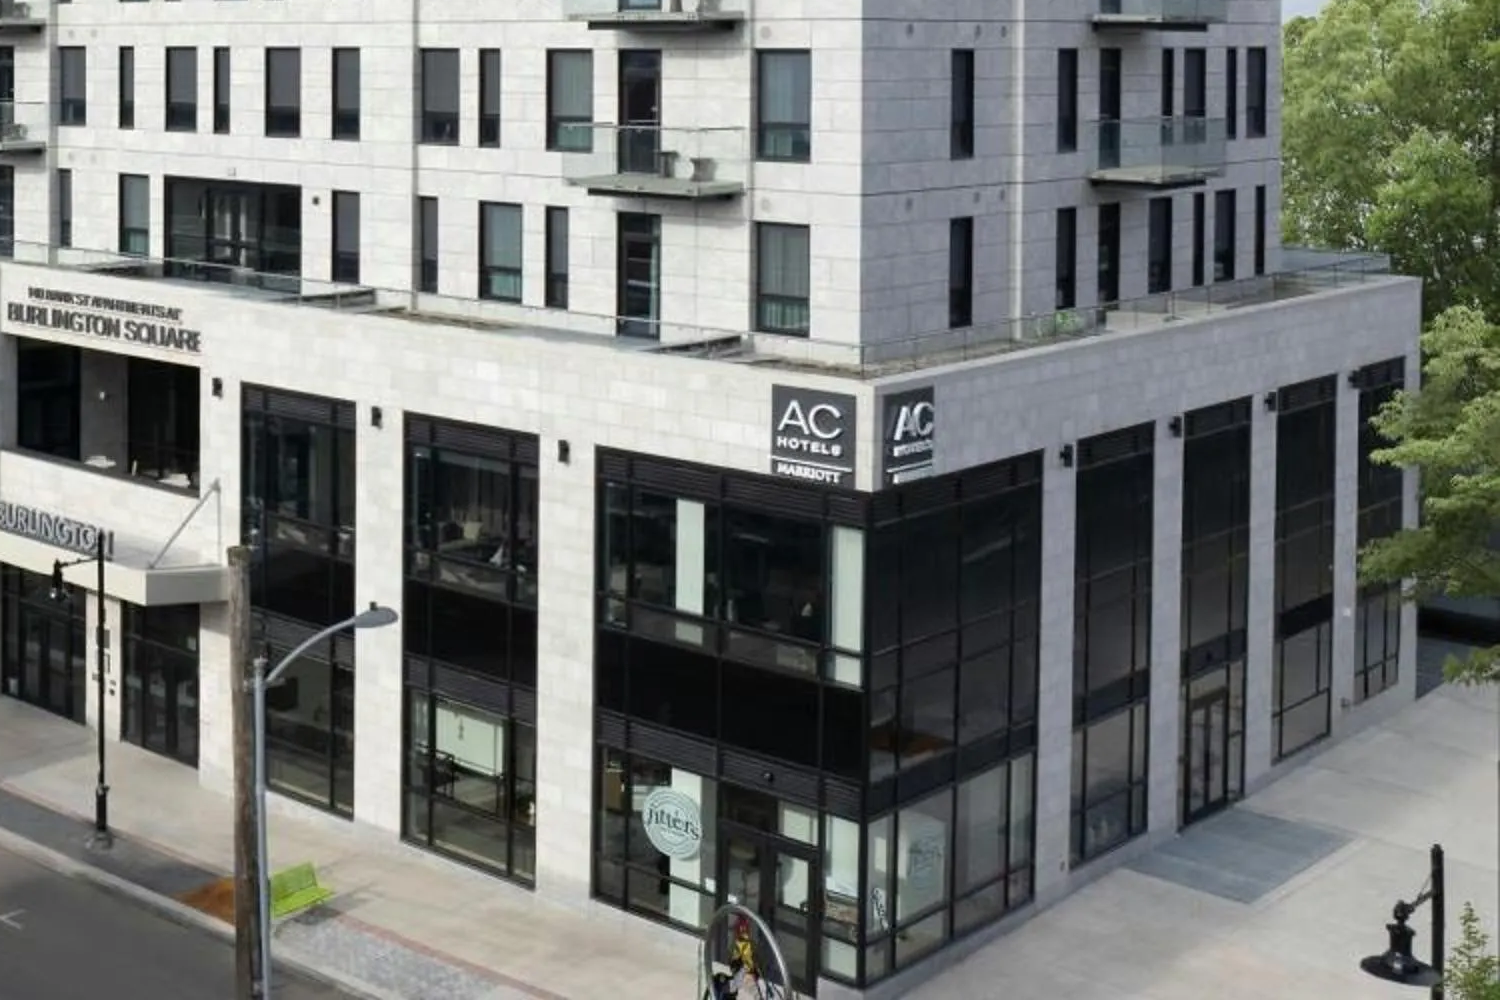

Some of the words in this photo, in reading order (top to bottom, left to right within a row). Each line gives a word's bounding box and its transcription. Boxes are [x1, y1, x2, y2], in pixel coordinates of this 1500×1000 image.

[8, 302, 120, 339] BURLINGTON
[124, 319, 201, 353] SQUARE
[777, 400, 842, 439] AC
[893, 402, 935, 441] AC
[776, 436, 842, 457] HOTELS
[776, 462, 841, 484] MARRIOTT
